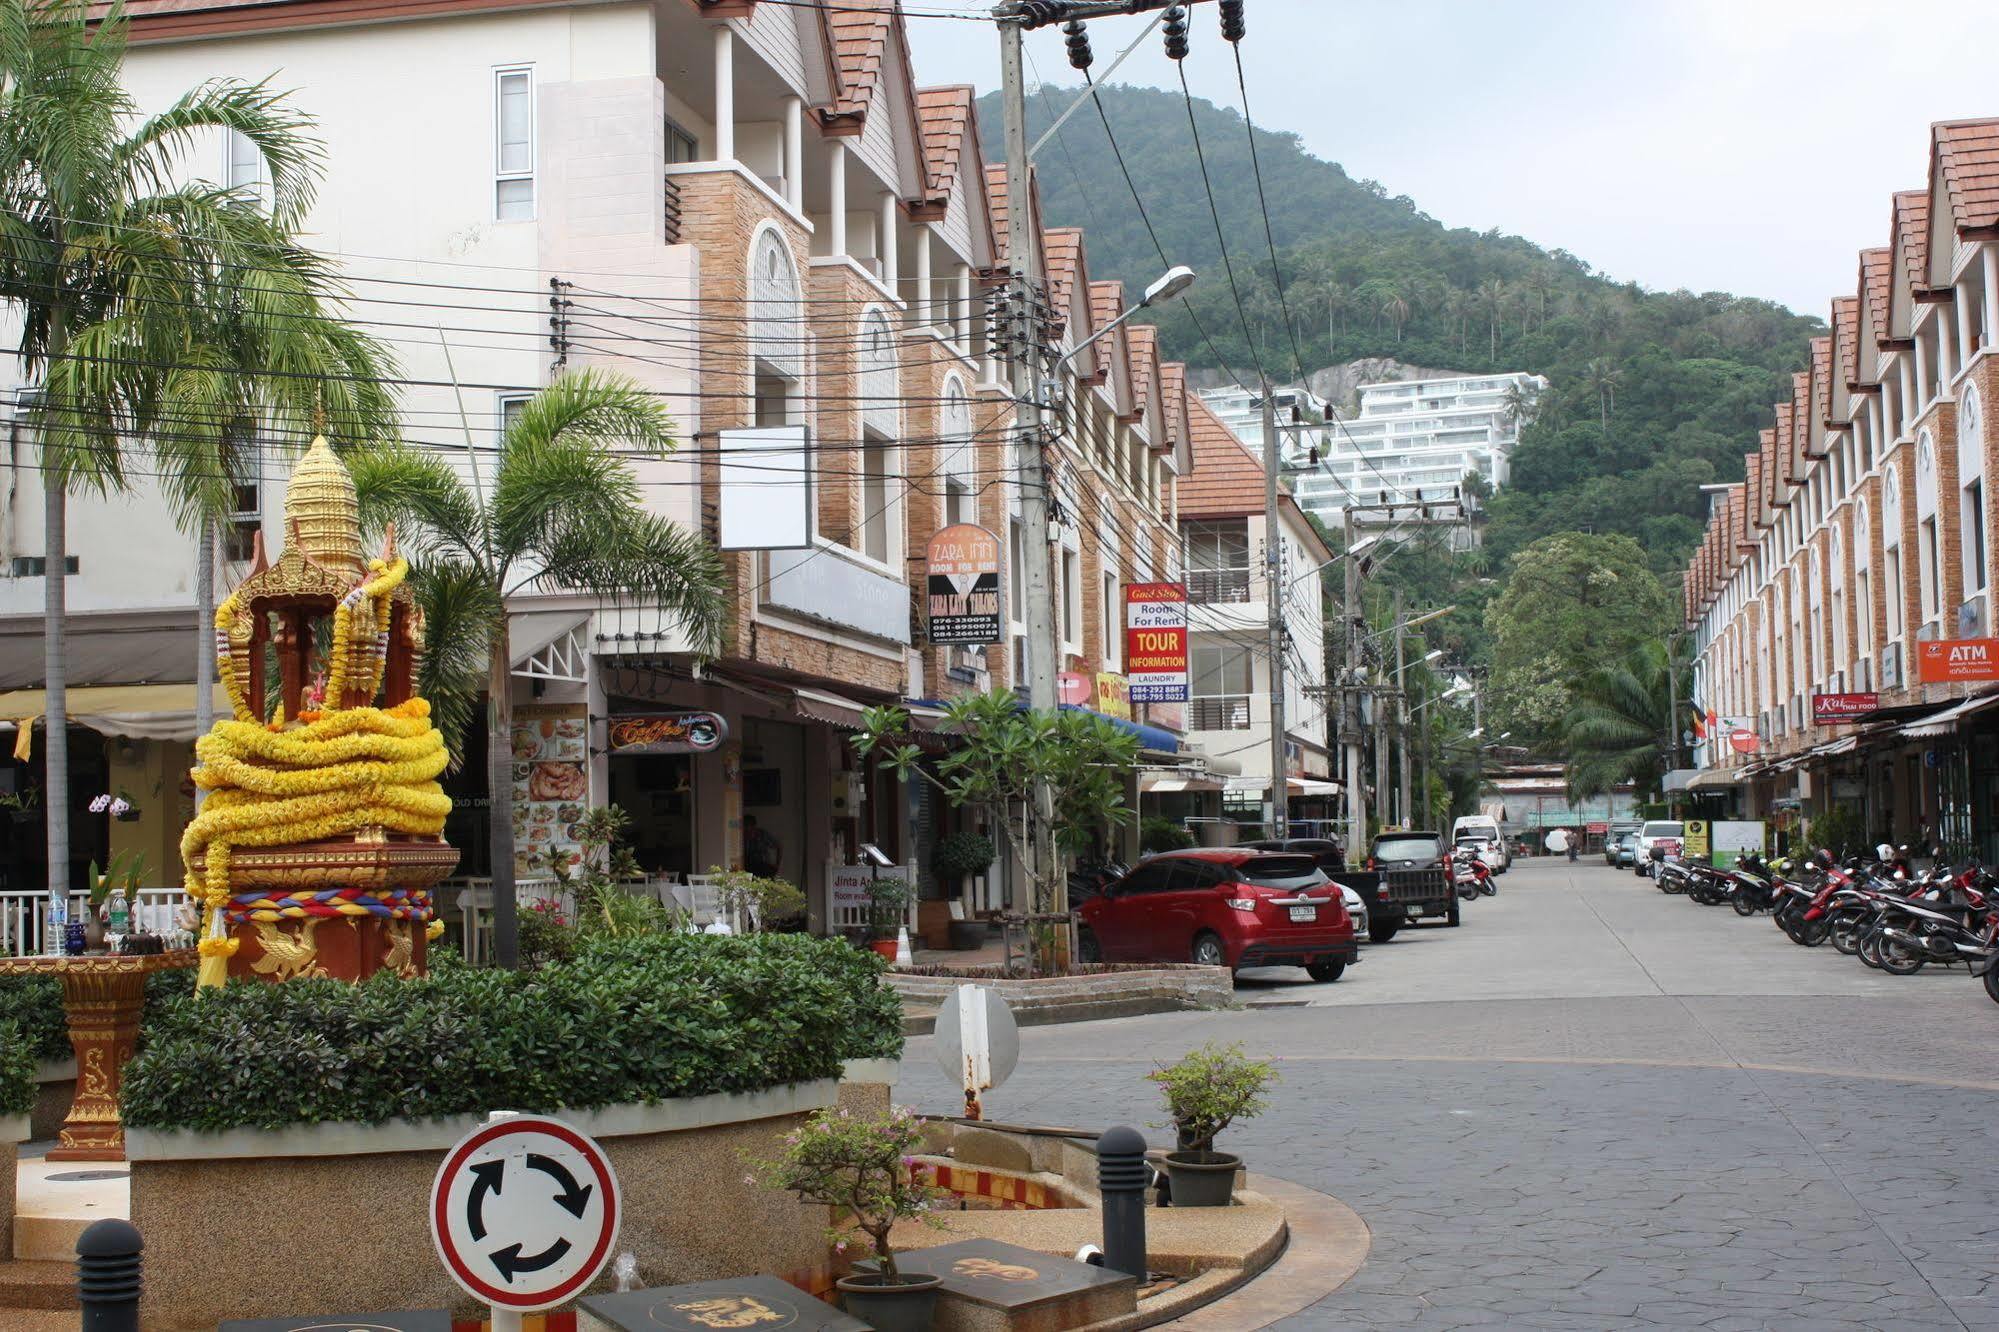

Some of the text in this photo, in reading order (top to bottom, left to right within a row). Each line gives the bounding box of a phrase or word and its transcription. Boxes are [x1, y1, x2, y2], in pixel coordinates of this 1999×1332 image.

[934, 543, 993, 561] ZARA INN
[930, 561, 997, 573] ROOM FOR RENT
[1141, 604, 1174, 614] Room
[1134, 616, 1180, 626] For Rent
[1137, 632, 1179, 652] TOUR
[1949, 645, 1987, 661] ATM
[1129, 656, 1185, 668] INFORMATION
[1138, 675, 1176, 683] LAUNDRY
[1815, 697, 1845, 712] Kai
[834, 875, 857, 887] Jinta
